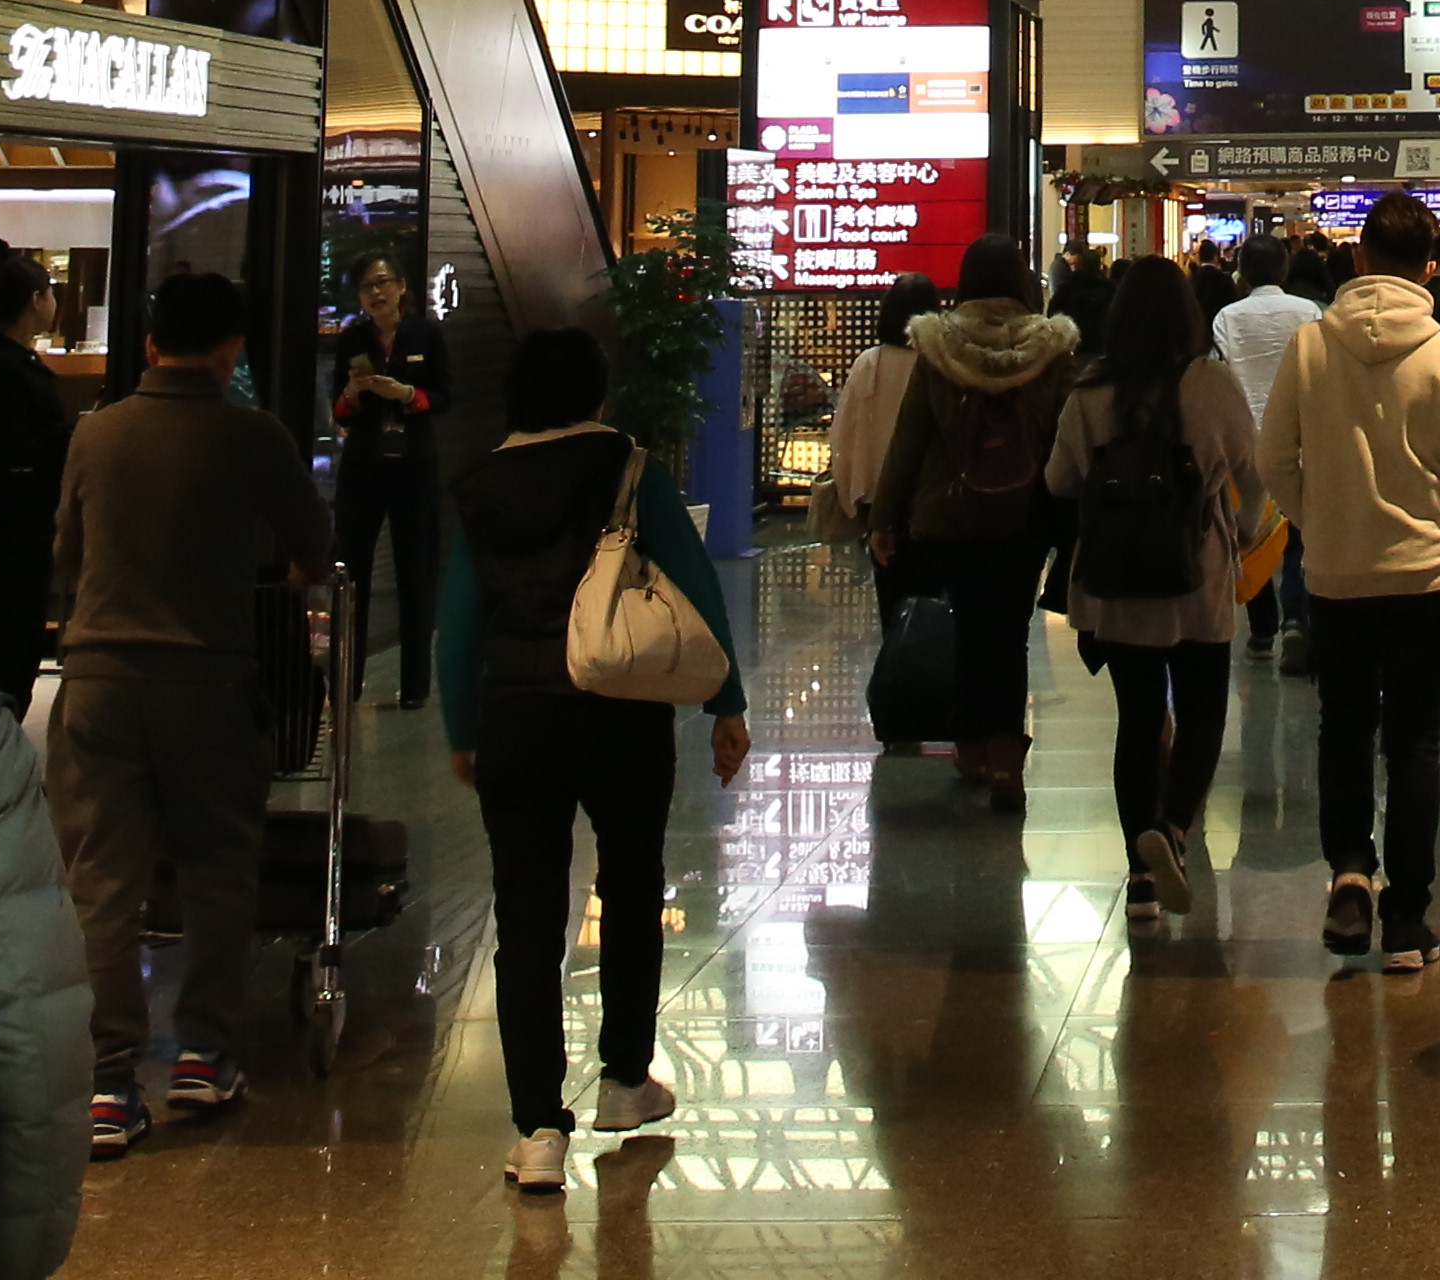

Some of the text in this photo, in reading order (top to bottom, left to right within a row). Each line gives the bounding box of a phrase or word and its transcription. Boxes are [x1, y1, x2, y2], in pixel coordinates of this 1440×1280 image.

[838, 13, 907, 28] VIP lounge
[50, 27, 211, 117] MACALLAN
[795, 186, 834, 200] Salon
[849, 187, 877, 202] Spa
[834, 205, 918, 228] 美食廣場
[834, 228, 908, 242] Food court
[794, 248, 877, 271] 按摩服務
[794, 271, 898, 289] Massage servic
